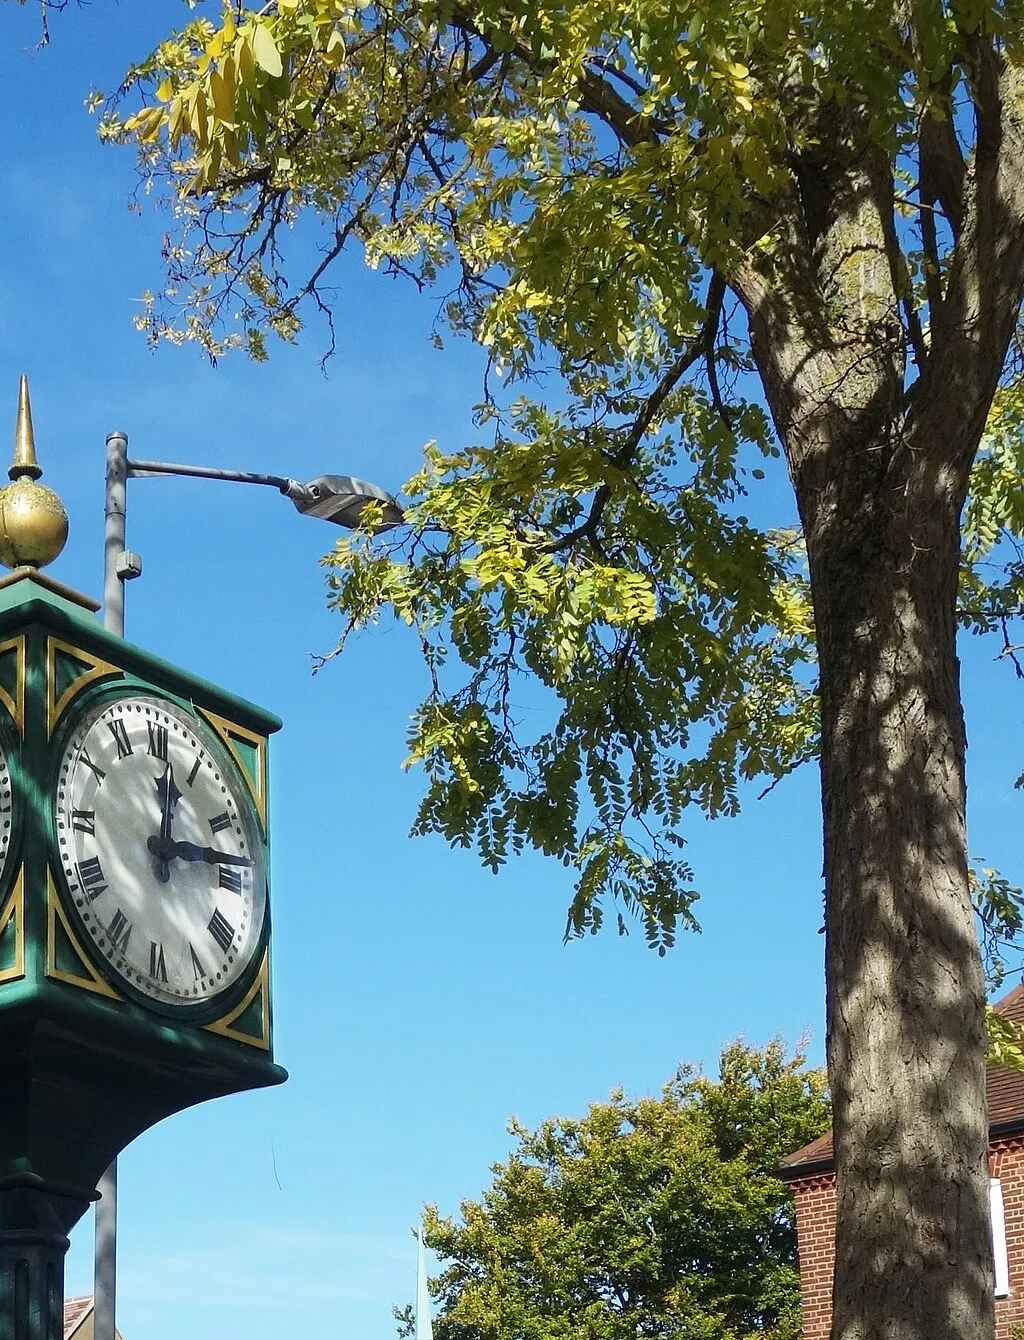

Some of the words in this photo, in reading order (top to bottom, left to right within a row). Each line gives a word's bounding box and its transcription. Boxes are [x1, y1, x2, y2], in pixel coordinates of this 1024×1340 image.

[107, 718, 134, 760] XI
[79, 747, 106, 787] X
[186, 757, 202, 788] I
[209, 812, 232, 835] II
